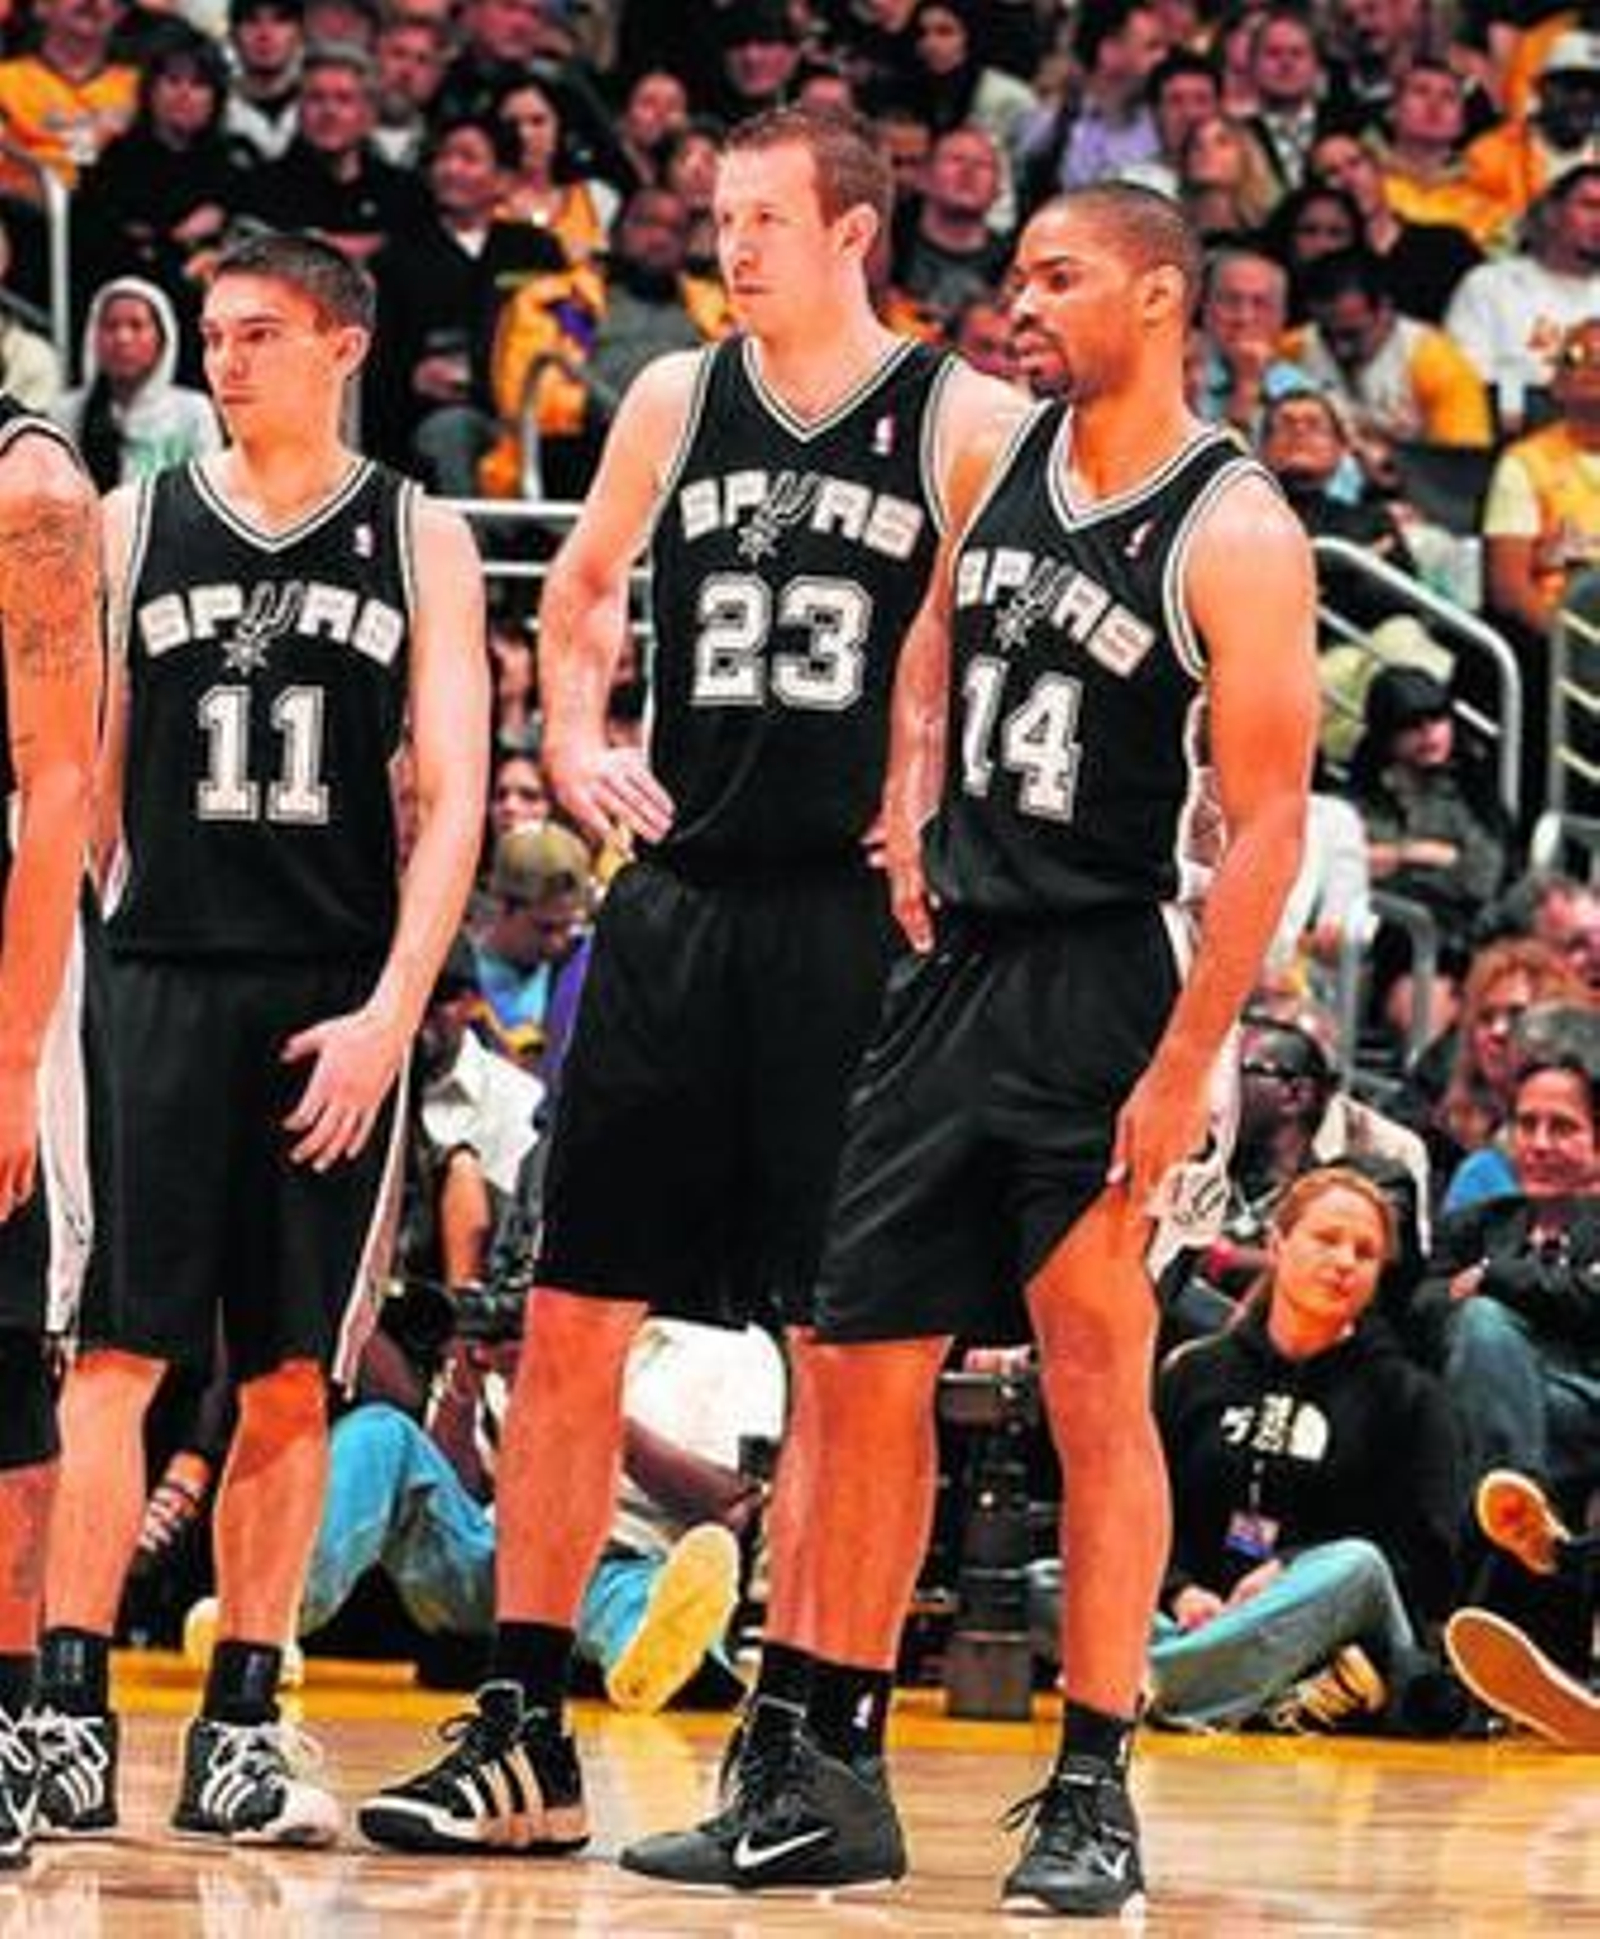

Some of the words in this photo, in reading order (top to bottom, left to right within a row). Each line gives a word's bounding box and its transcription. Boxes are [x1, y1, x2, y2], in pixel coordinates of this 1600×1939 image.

[679, 470, 925, 562] SPURS
[137, 580, 405, 675] SPURS
[690, 572, 873, 712] 23
[197, 685, 330, 825] 11
[959, 654, 1083, 823] 14
